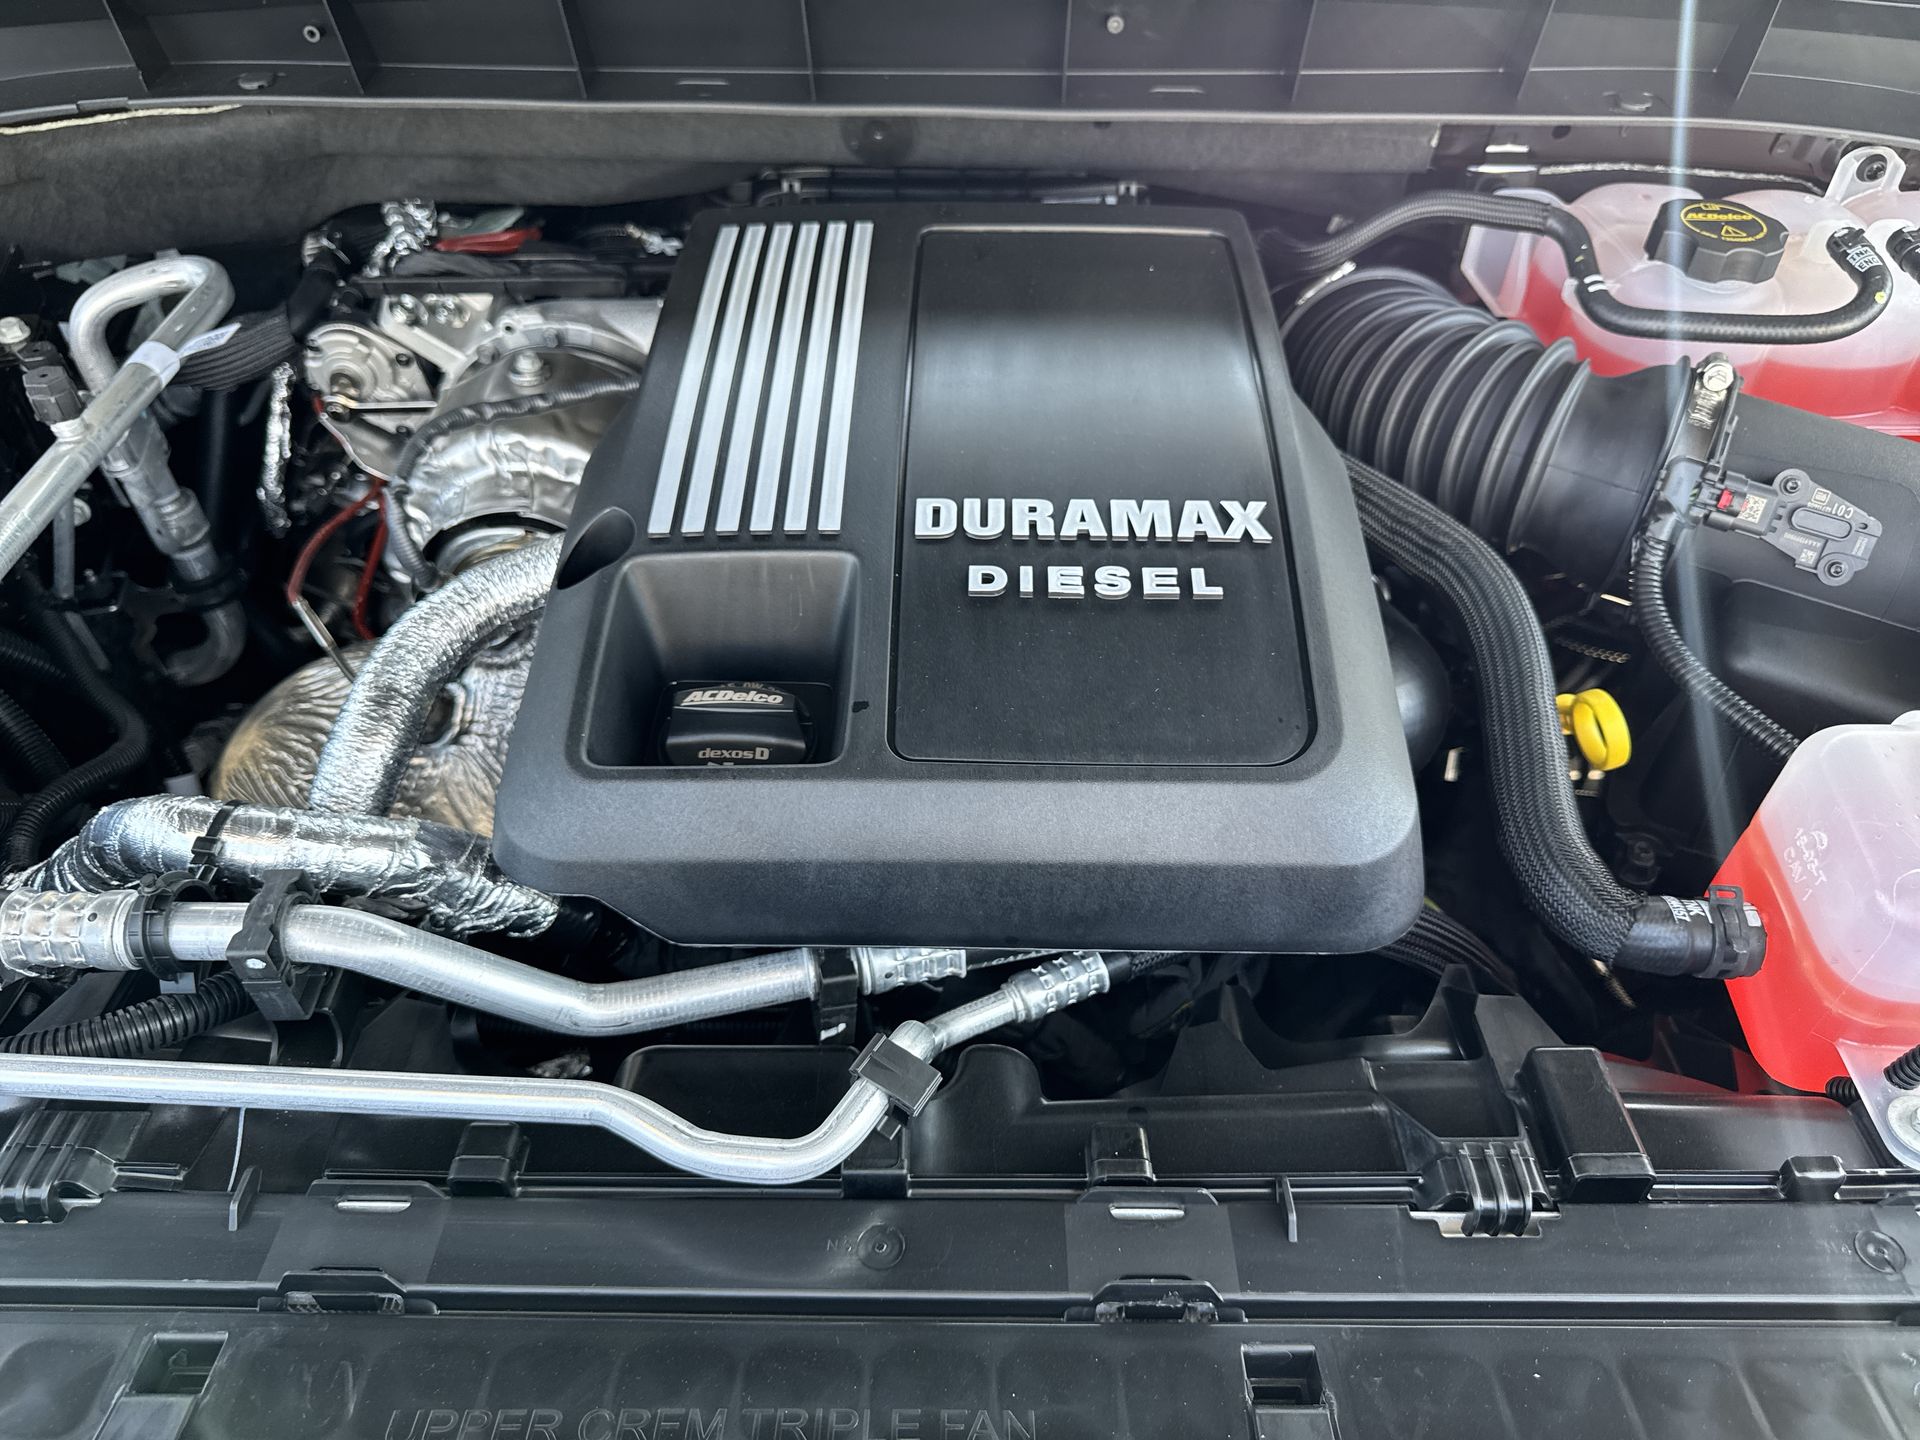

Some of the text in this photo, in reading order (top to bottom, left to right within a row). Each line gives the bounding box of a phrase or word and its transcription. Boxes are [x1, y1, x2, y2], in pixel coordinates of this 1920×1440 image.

[914, 497, 1273, 544] DURAMAX
[967, 564, 1224, 599] DIESEL
[682, 690, 784, 704] ACDelco
[742, 1407, 922, 1440] TRIPLE
[940, 1408, 1036, 1440] FAN
